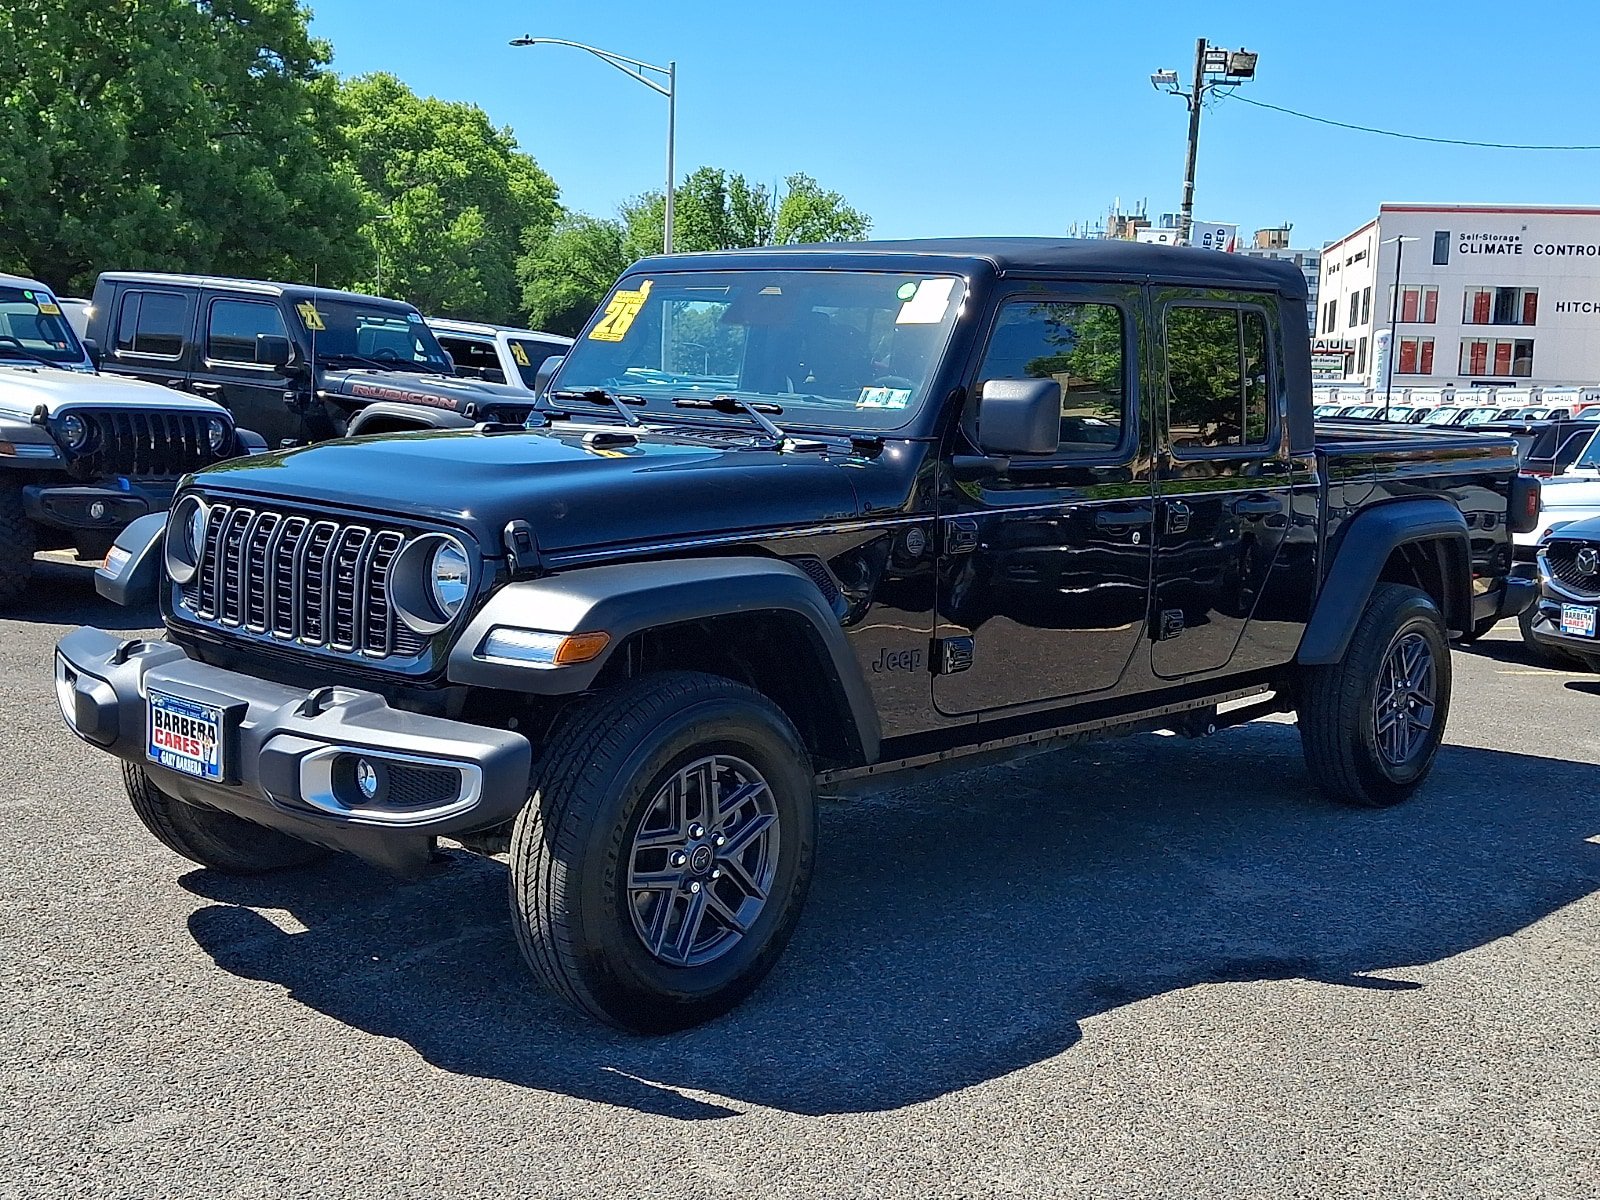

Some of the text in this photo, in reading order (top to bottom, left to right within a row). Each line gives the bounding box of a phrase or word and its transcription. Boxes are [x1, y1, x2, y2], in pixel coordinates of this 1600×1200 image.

[1459, 233, 1520, 242] Self-Storage
[1459, 243, 1523, 255] CLIMATE
[1315, 340, 1353, 349] AUL
[352, 384, 458, 408] RUBICON
[1565, 611, 1592, 622] BARBERA
[1564, 618, 1584, 628] CARES
[872, 648, 920, 673] Jeep
[154, 708, 216, 745] BARBERA
[154, 728, 200, 756] CARES
